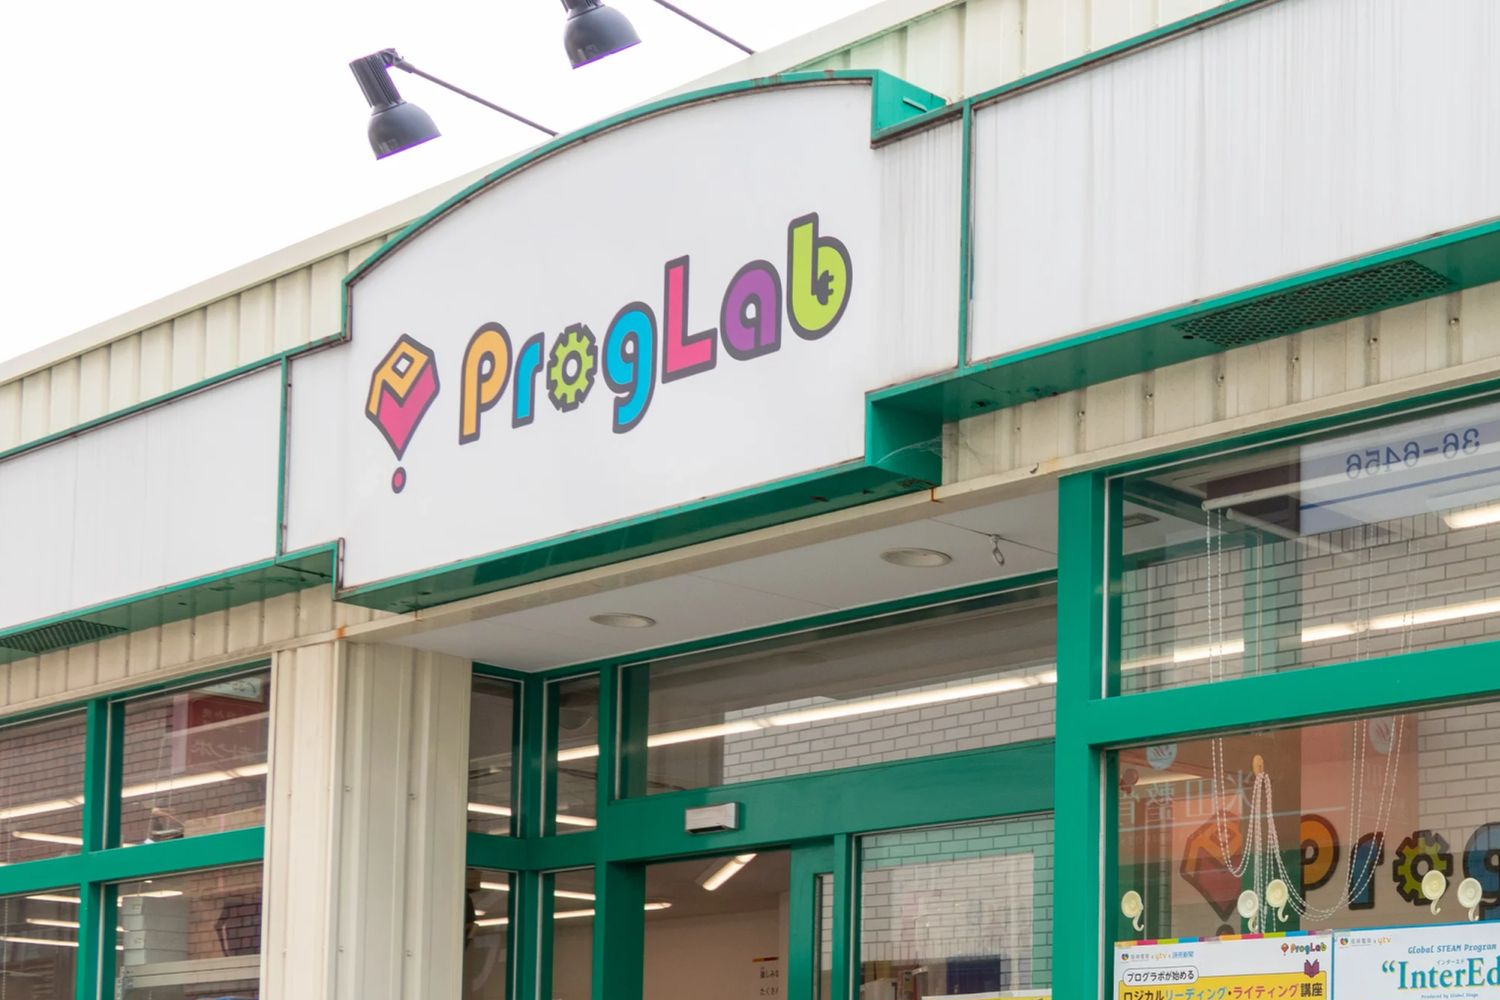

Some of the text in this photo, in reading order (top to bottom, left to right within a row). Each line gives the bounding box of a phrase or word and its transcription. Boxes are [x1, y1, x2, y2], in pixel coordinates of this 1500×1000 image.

[458, 211, 853, 446] ProgLab
[1290, 942, 1327, 955] ProgLab
[1408, 943, 1497, 954] Global STEAM Program
[1126, 970, 1195, 983] プログラボが始める
